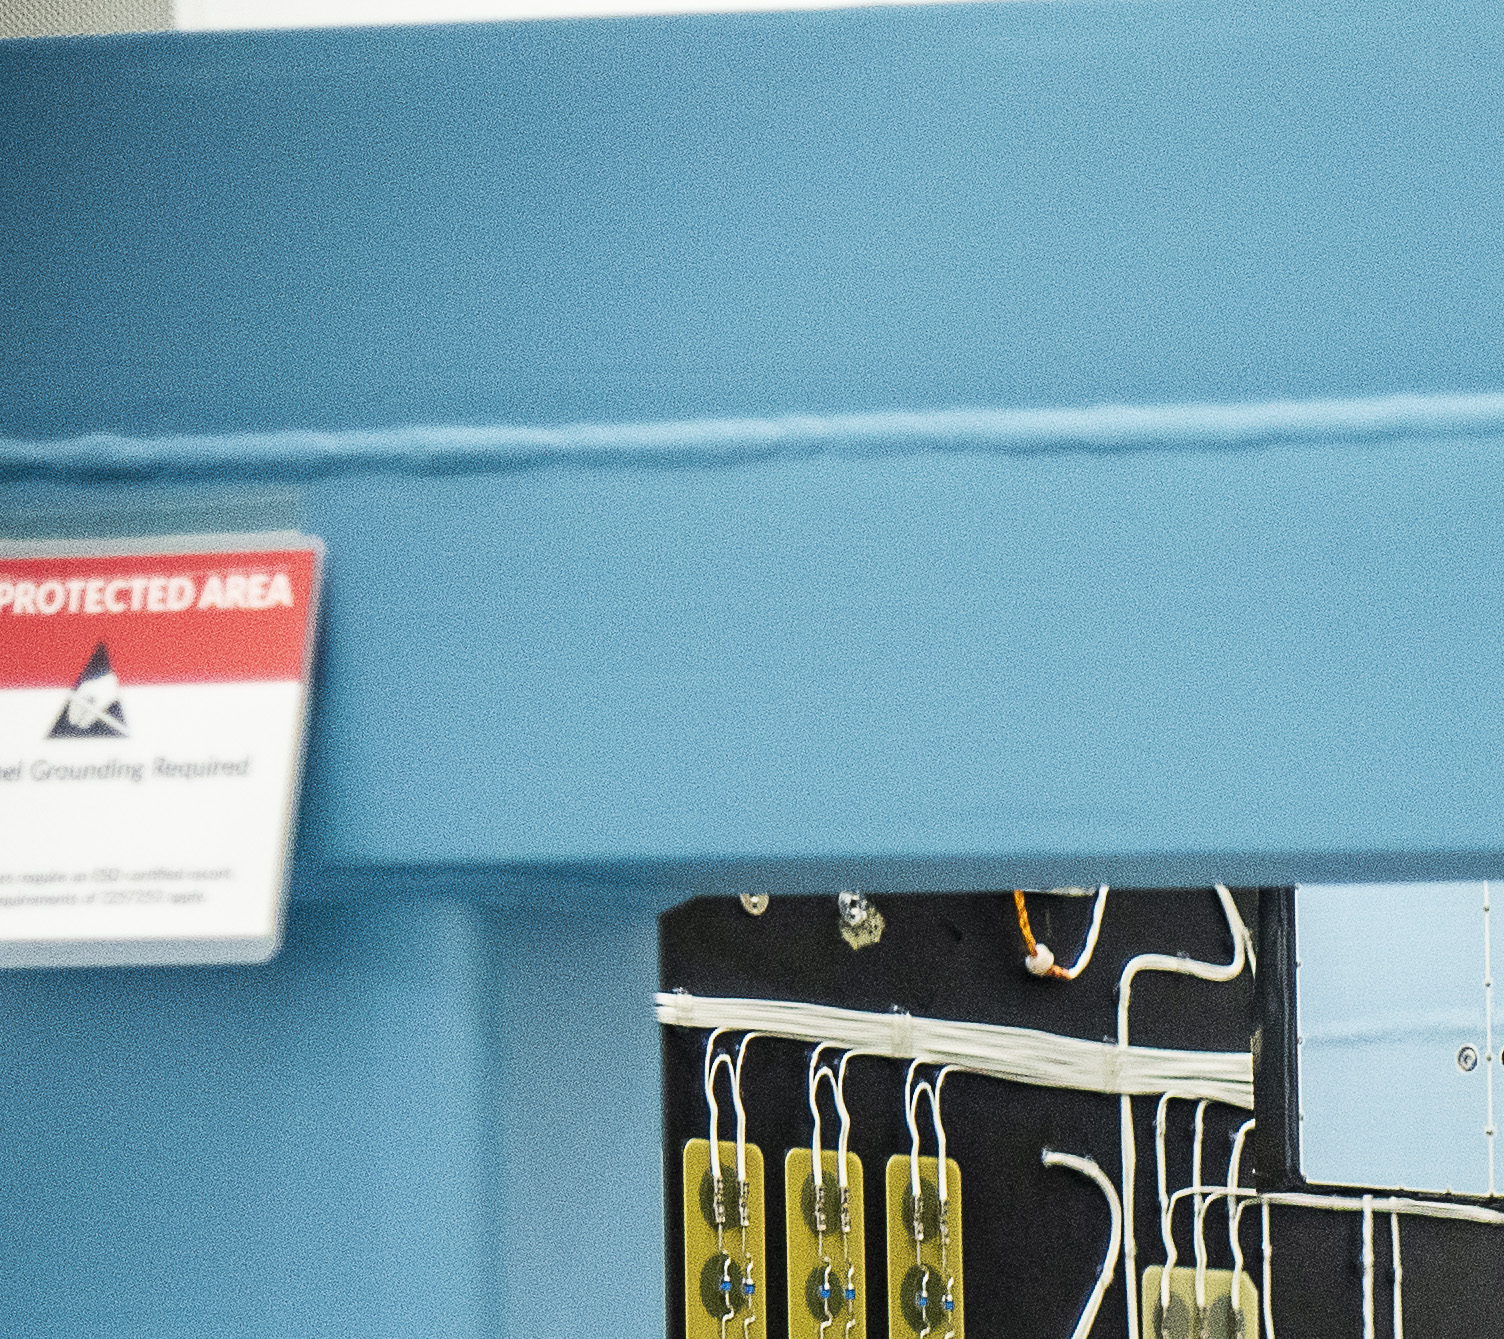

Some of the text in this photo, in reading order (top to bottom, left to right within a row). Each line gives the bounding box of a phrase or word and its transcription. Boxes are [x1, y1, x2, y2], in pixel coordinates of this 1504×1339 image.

[0, 573, 294, 614] PROTECTED AREA
[30, 758, 143, 782] Grounding
[153, 756, 249, 780] Required
